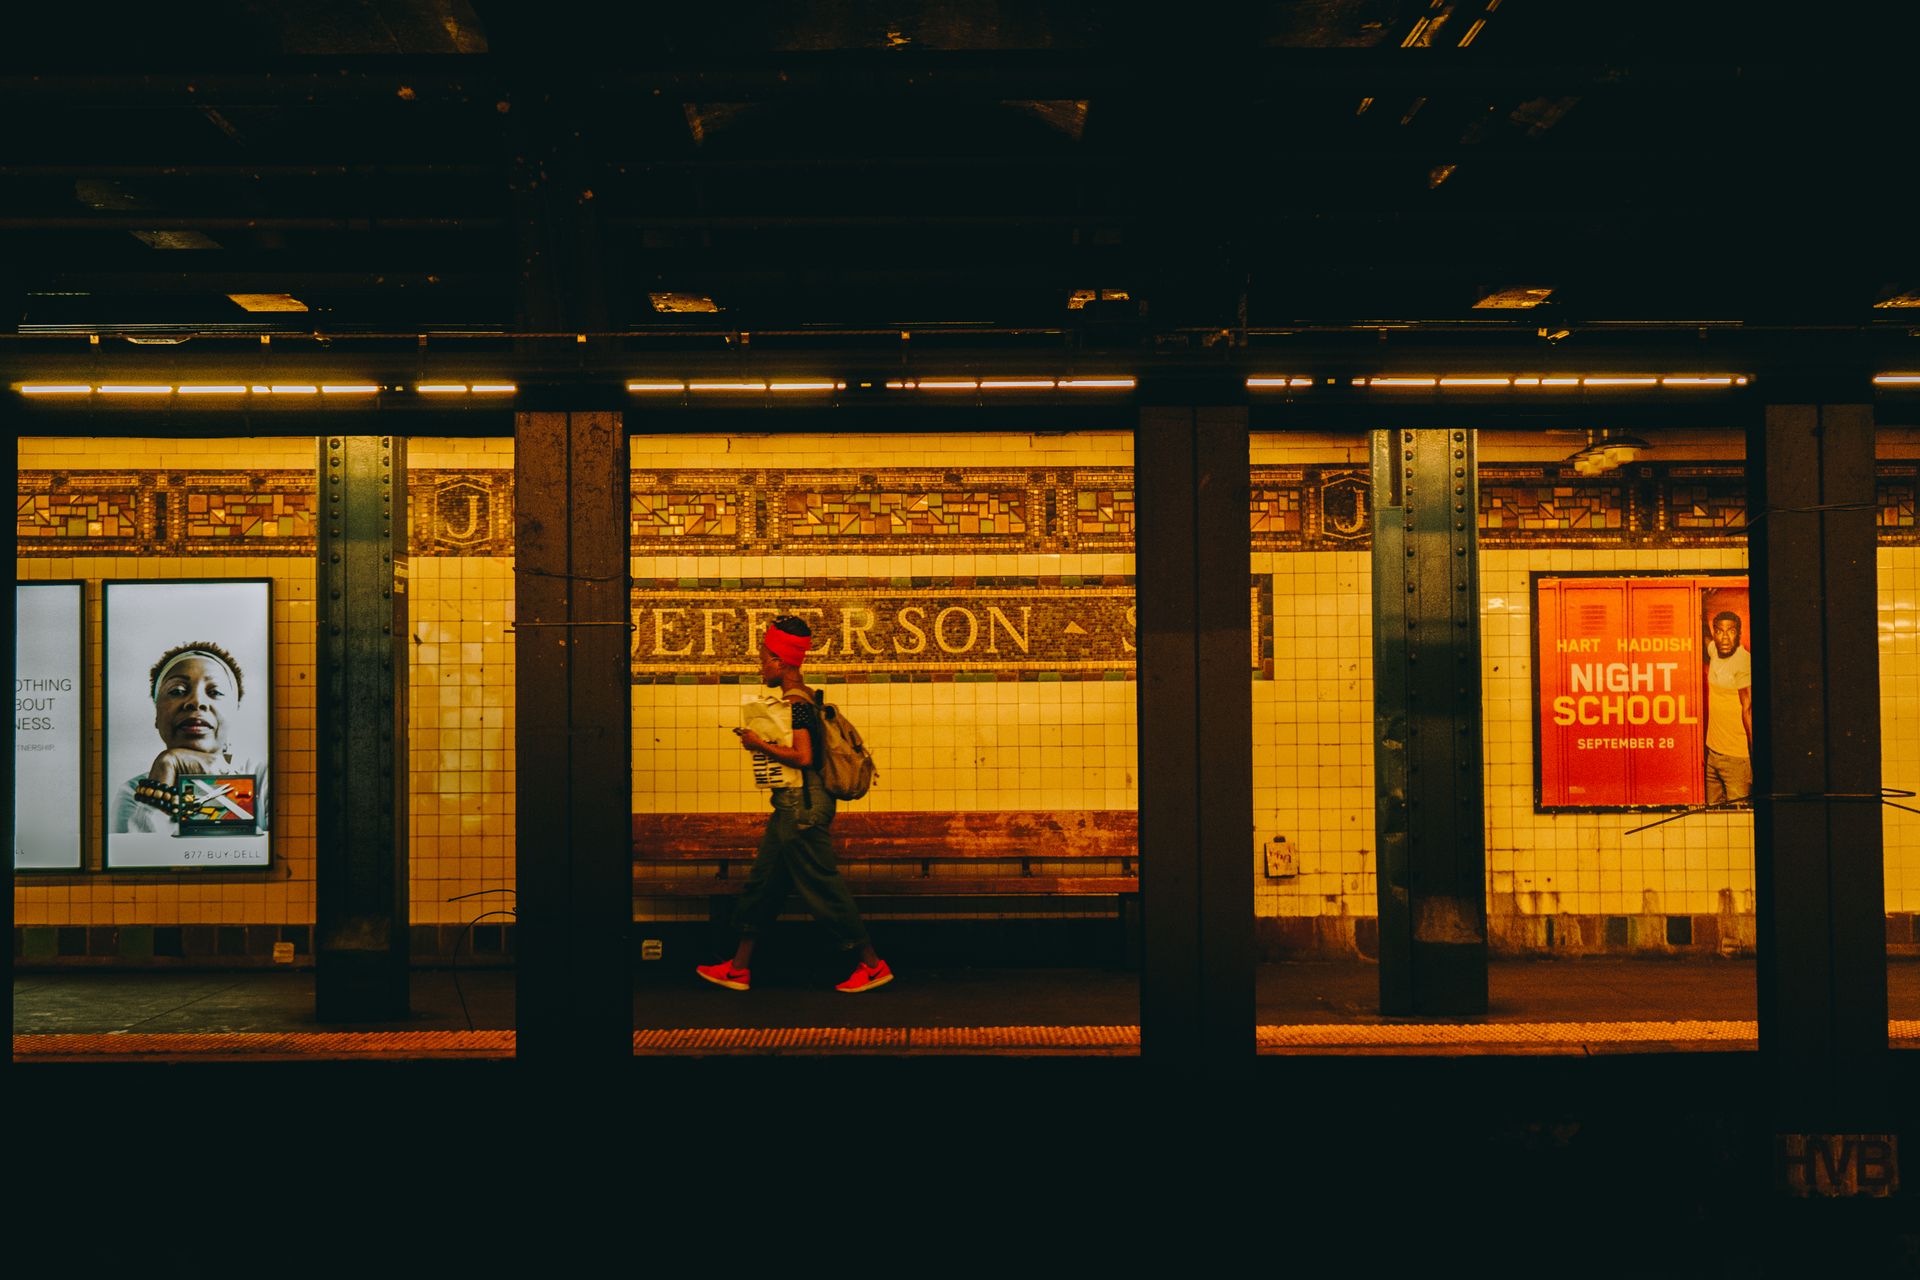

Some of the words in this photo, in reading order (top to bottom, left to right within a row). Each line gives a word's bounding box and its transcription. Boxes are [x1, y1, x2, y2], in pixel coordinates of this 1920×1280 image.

[446, 495, 480, 539] J
[1334, 486, 1365, 533] J
[1556, 638, 1600, 653] HART
[1617, 637, 1692, 653] HADDISH
[1571, 662, 1678, 693] NIGHT
[1553, 694, 1698, 726] SCHOOL
[1577, 737, 1654, 750] SEPTEMBER
[1658, 737, 1675, 749] 28
